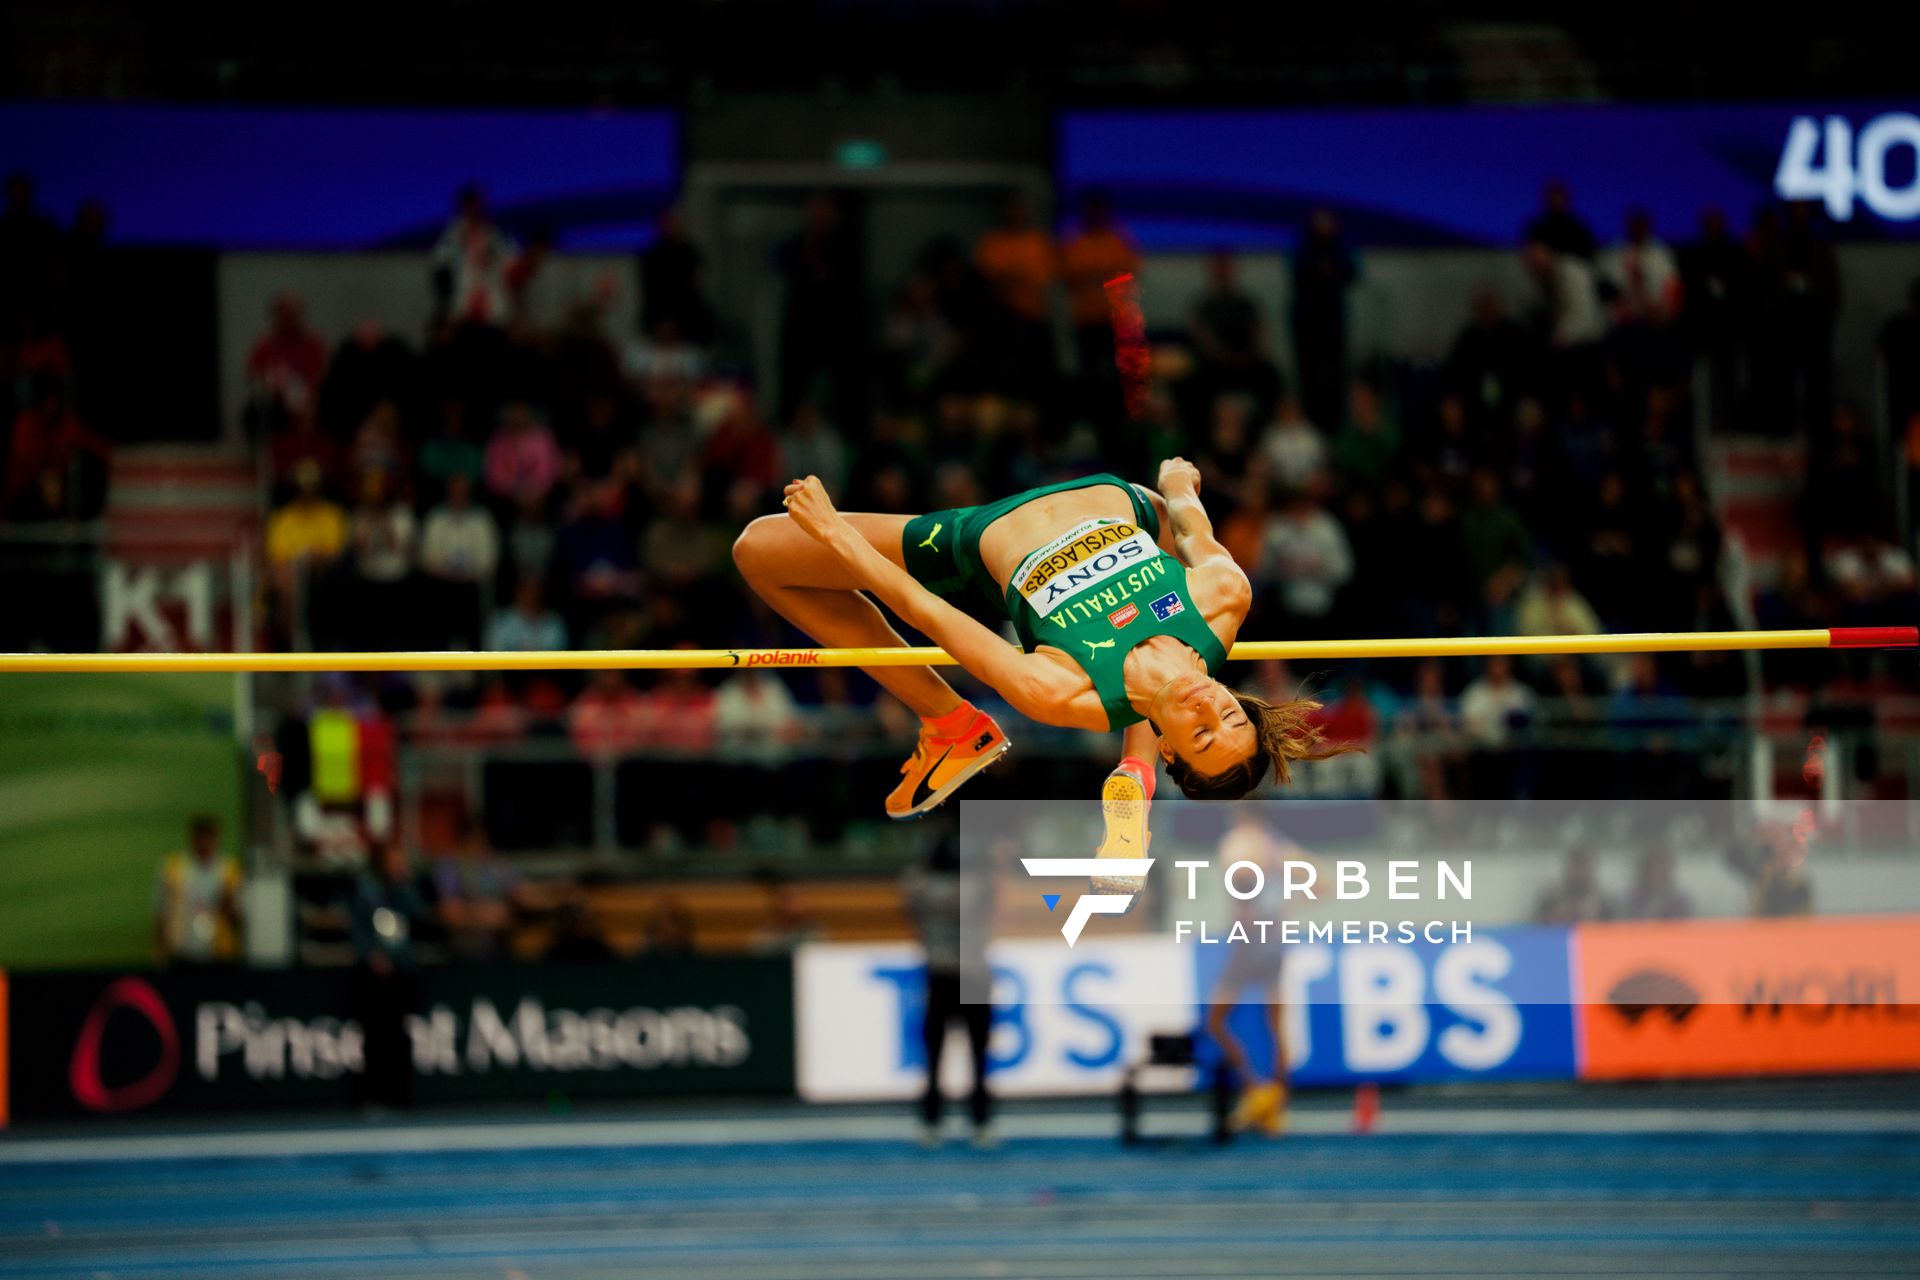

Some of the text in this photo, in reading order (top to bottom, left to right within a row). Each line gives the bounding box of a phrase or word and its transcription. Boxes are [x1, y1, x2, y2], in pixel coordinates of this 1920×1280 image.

[1773, 112, 1920, 223] 40
[1025, 525, 1134, 594] OLYSLAGERS
[1046, 540, 1144, 604] SONY
[1049, 557, 1166, 629] AUSTRALIA
[748, 650, 819, 667] polanik
[468, 997, 749, 1073] Masons
